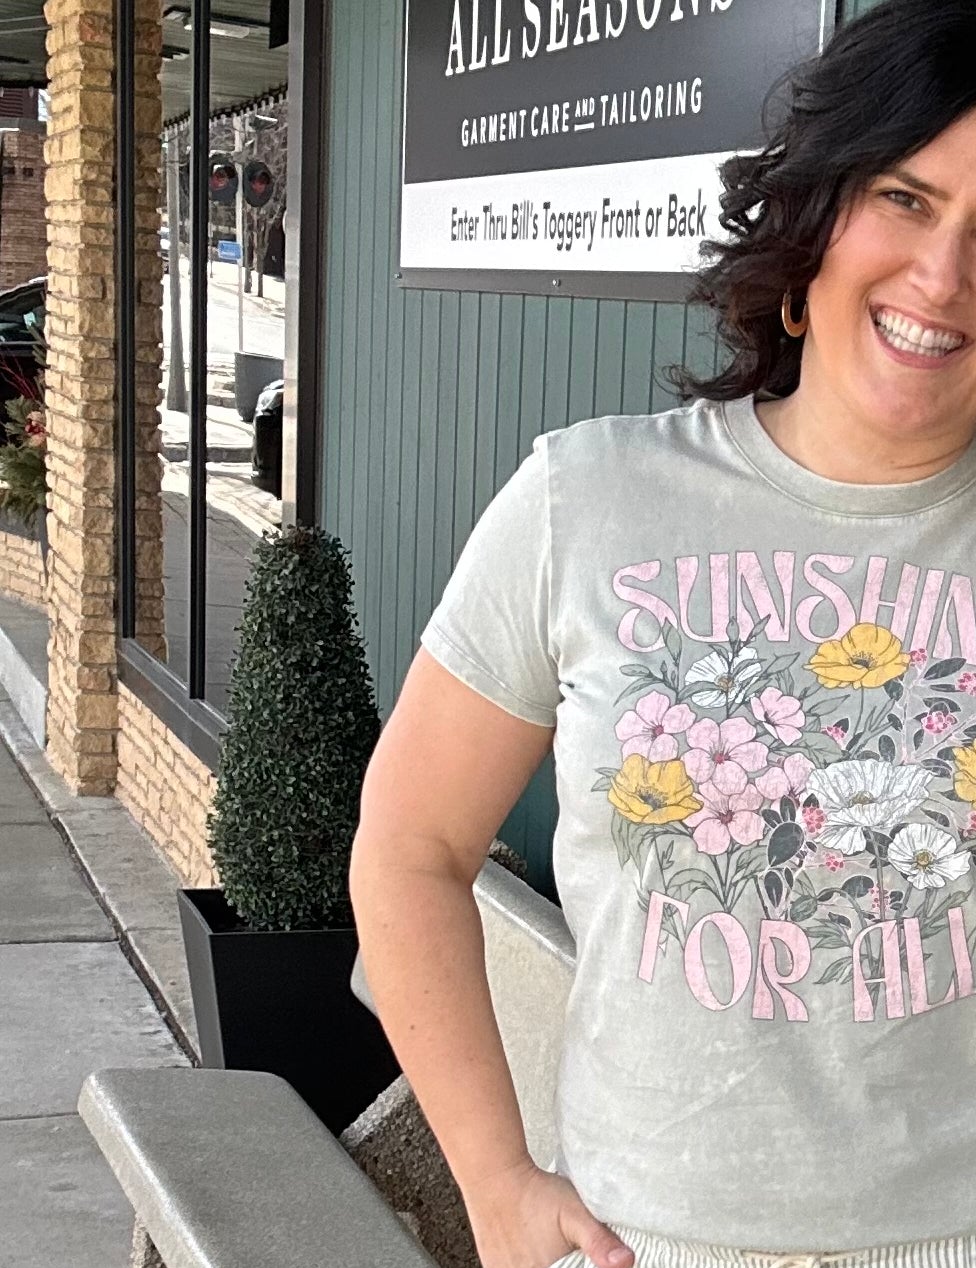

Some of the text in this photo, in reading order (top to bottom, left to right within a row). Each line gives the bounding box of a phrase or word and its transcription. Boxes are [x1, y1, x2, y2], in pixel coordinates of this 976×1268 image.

[445, 0, 511, 76] ALL
[461, 77, 703, 147] GARMENT CARE AND TAILORING
[450, 189, 708, 251] Enter Thru Bill's Toggery Front or Back
[637, 891, 812, 1022] FOR
